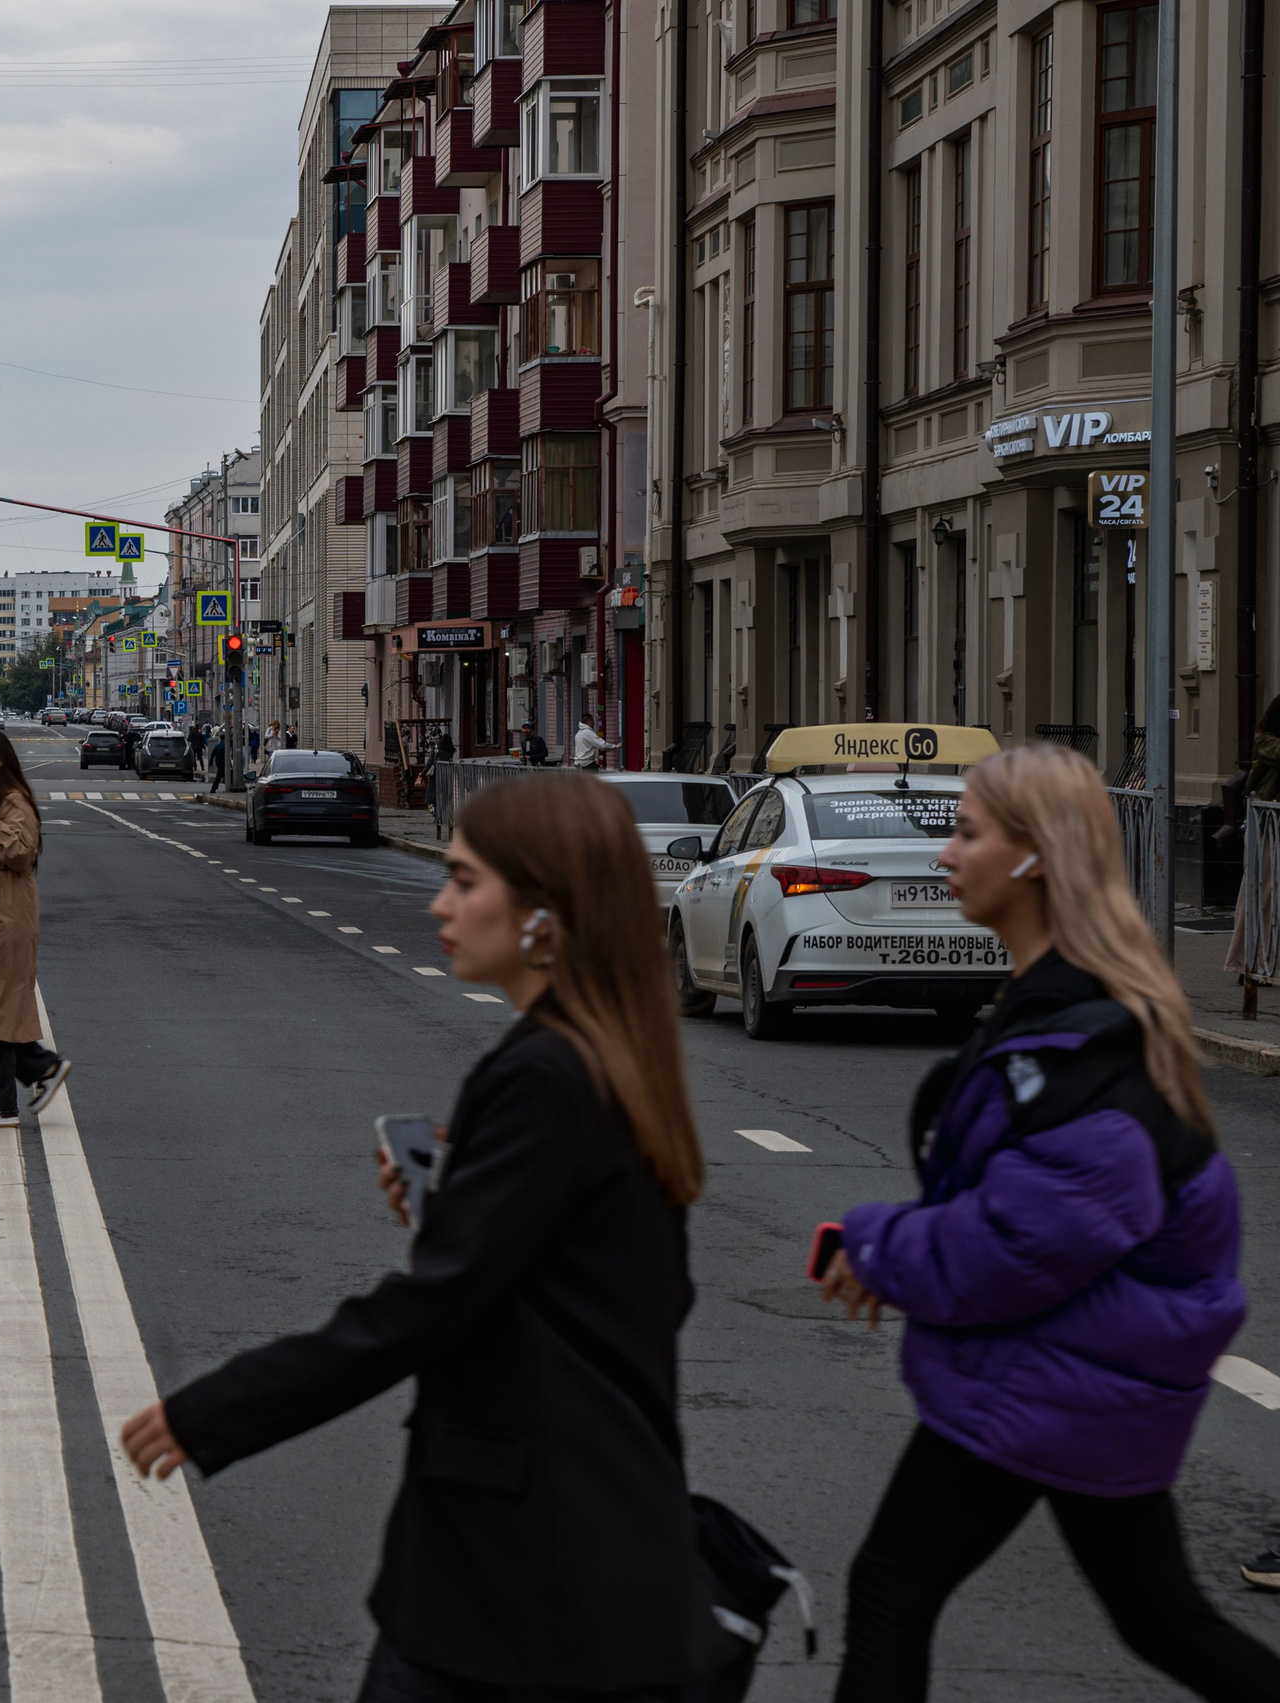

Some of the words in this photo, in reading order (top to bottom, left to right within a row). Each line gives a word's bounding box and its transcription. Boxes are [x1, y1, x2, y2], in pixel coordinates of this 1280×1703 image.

[1042, 412, 1109, 448] VIP
[1100, 474, 1146, 492] VIP
[1099, 494, 1144, 518] 24
[834, 733, 899, 758] Яндекс
[908, 732, 934, 756] Go
[830, 799, 892, 808] Экономь
[835, 805, 903, 814] переходи
[803, 936, 842, 949] НАБОР
[928, 936, 945, 949] НА
[949, 936, 994, 950] НОВЫЕ
[879, 950, 1008, 966] т.260-01-01
